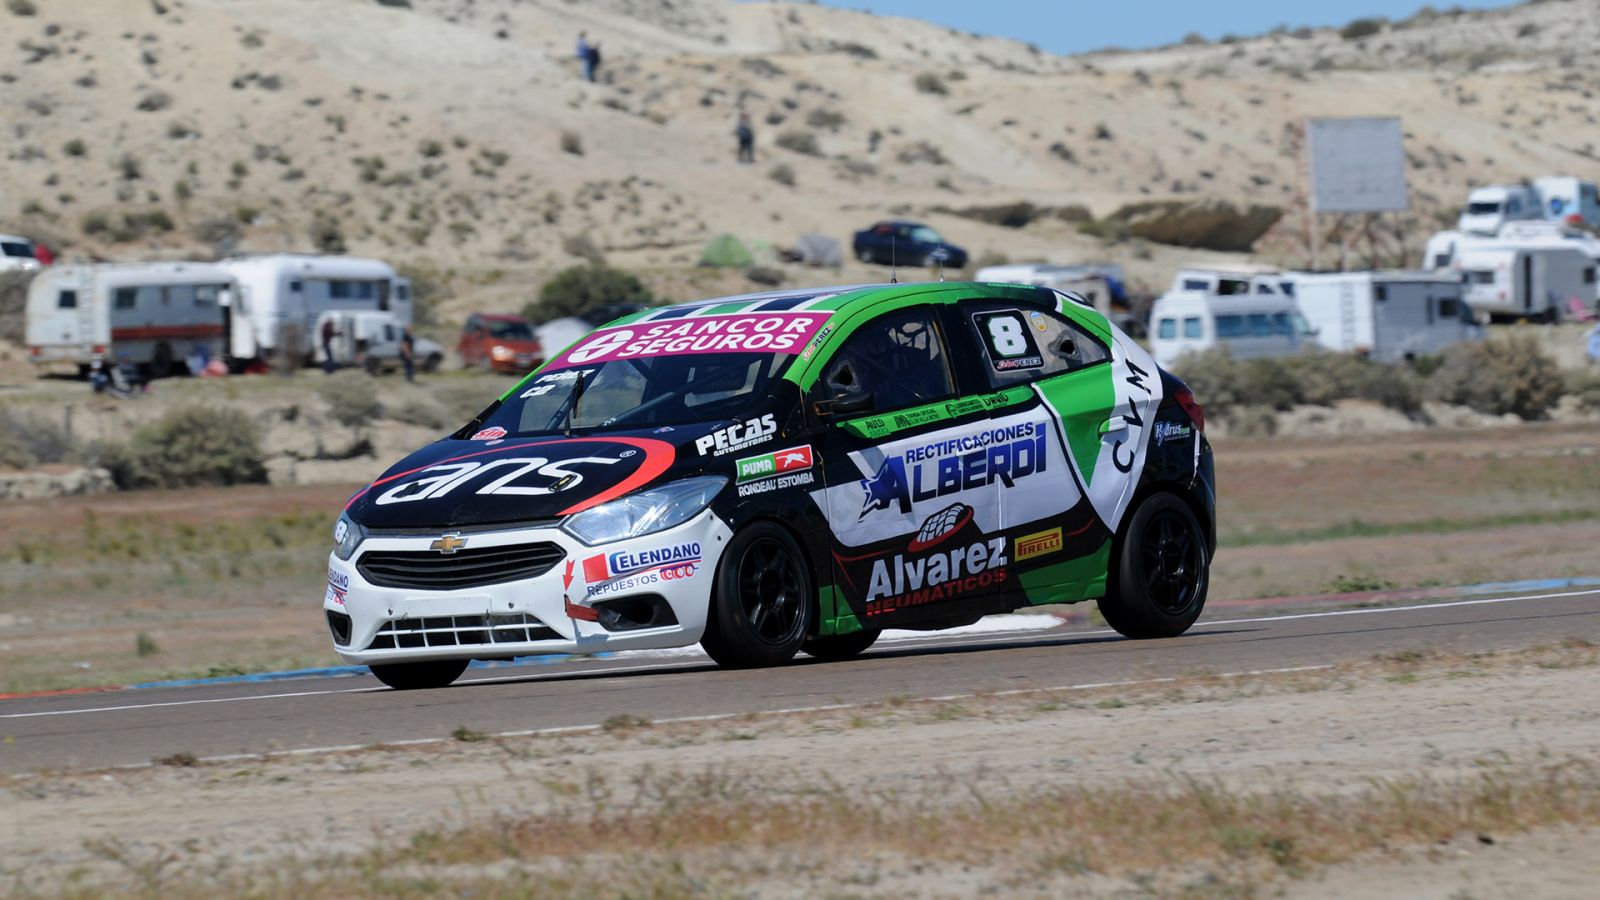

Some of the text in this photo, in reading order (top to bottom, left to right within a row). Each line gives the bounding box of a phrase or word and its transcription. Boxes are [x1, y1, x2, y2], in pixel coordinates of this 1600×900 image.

[639, 317, 813, 339] SANCOR
[988, 316, 1027, 356] 8
[617, 333, 800, 357] SEGUROS
[695, 413, 777, 456] PECAS
[713, 434, 773, 457] AUTOMOTORES
[906, 421, 1034, 464] RECTIFICACIONES
[742, 459, 773, 476] PUMA
[778, 472, 814, 489] ESTOMBA
[882, 422, 1047, 514] ALBERDI
[609, 542, 701, 574] CELENDANO
[1017, 532, 1060, 557] PIRELLI
[866, 536, 1008, 602] Alvarez
[587, 574, 658, 596] REPUESTOS
[866, 567, 1008, 616] NEUMATICOS
